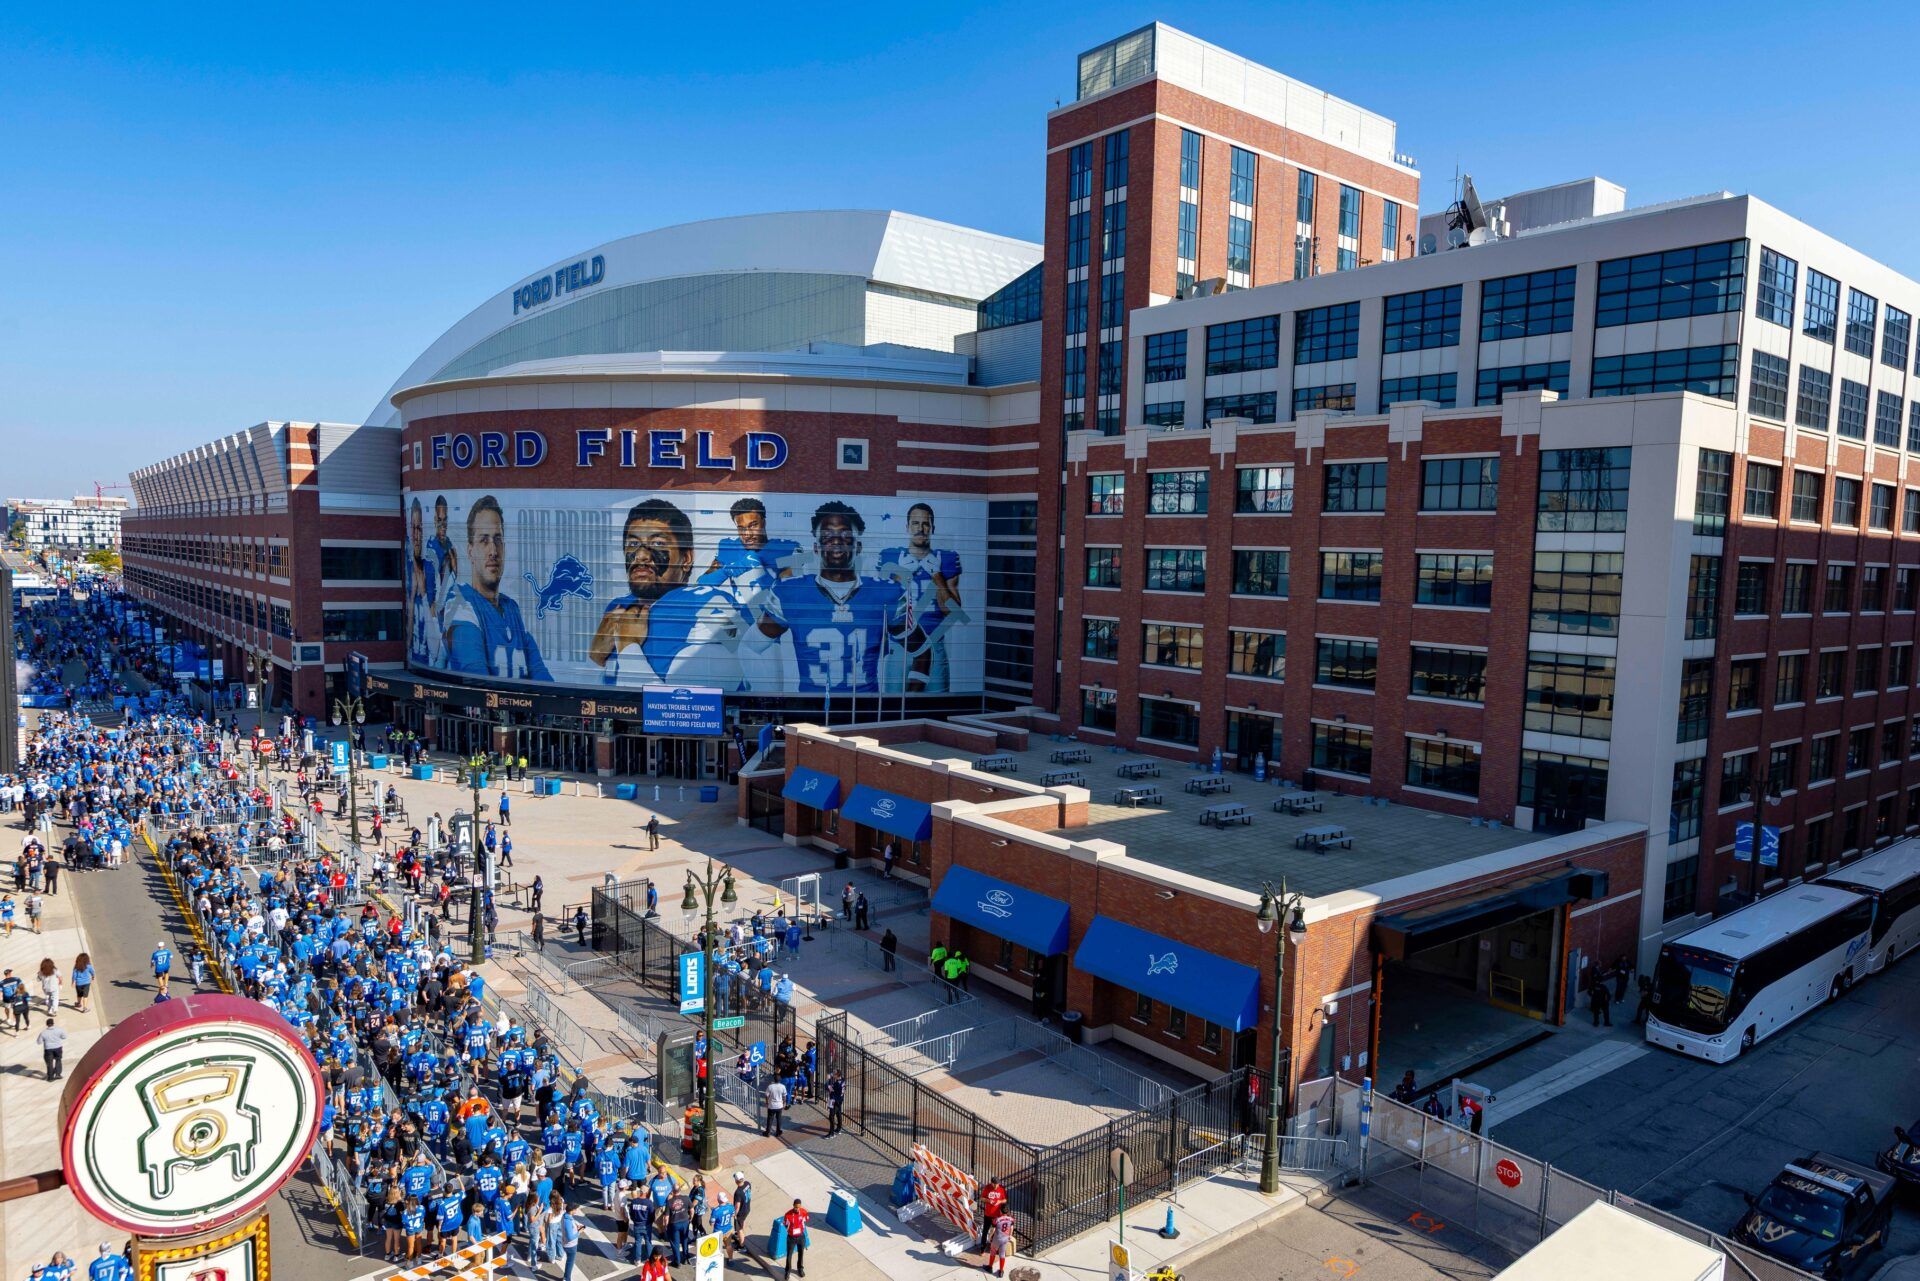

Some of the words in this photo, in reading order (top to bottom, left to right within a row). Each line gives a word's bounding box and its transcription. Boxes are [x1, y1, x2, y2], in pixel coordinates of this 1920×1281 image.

[513, 274, 553, 315] FORD
[555, 254, 605, 297] FIELD
[431, 430, 547, 470] FORD
[576, 428, 788, 470] FIELD
[806, 627, 868, 688] 31
[423, 688, 449, 699] BETMGM
[499, 697, 532, 708] BETMGM
[597, 703, 638, 716] BETMGM
[259, 742, 274, 751] STOP
[458, 826, 470, 844] A
[990, 891, 1009, 904] Ford
[158, 956, 167, 965] 97
[686, 958, 698, 995] LIONS
[371, 1018, 380, 1027] 24
[717, 1018, 742, 1028] Beacon
[471, 1036, 484, 1047] 20
[430, 1111, 438, 1120] 16
[1496, 1162, 1520, 1181] STOP
[411, 1178, 425, 1190] 32
[480, 1178, 496, 1191] 26
[1001, 1223, 1007, 1232] 8
